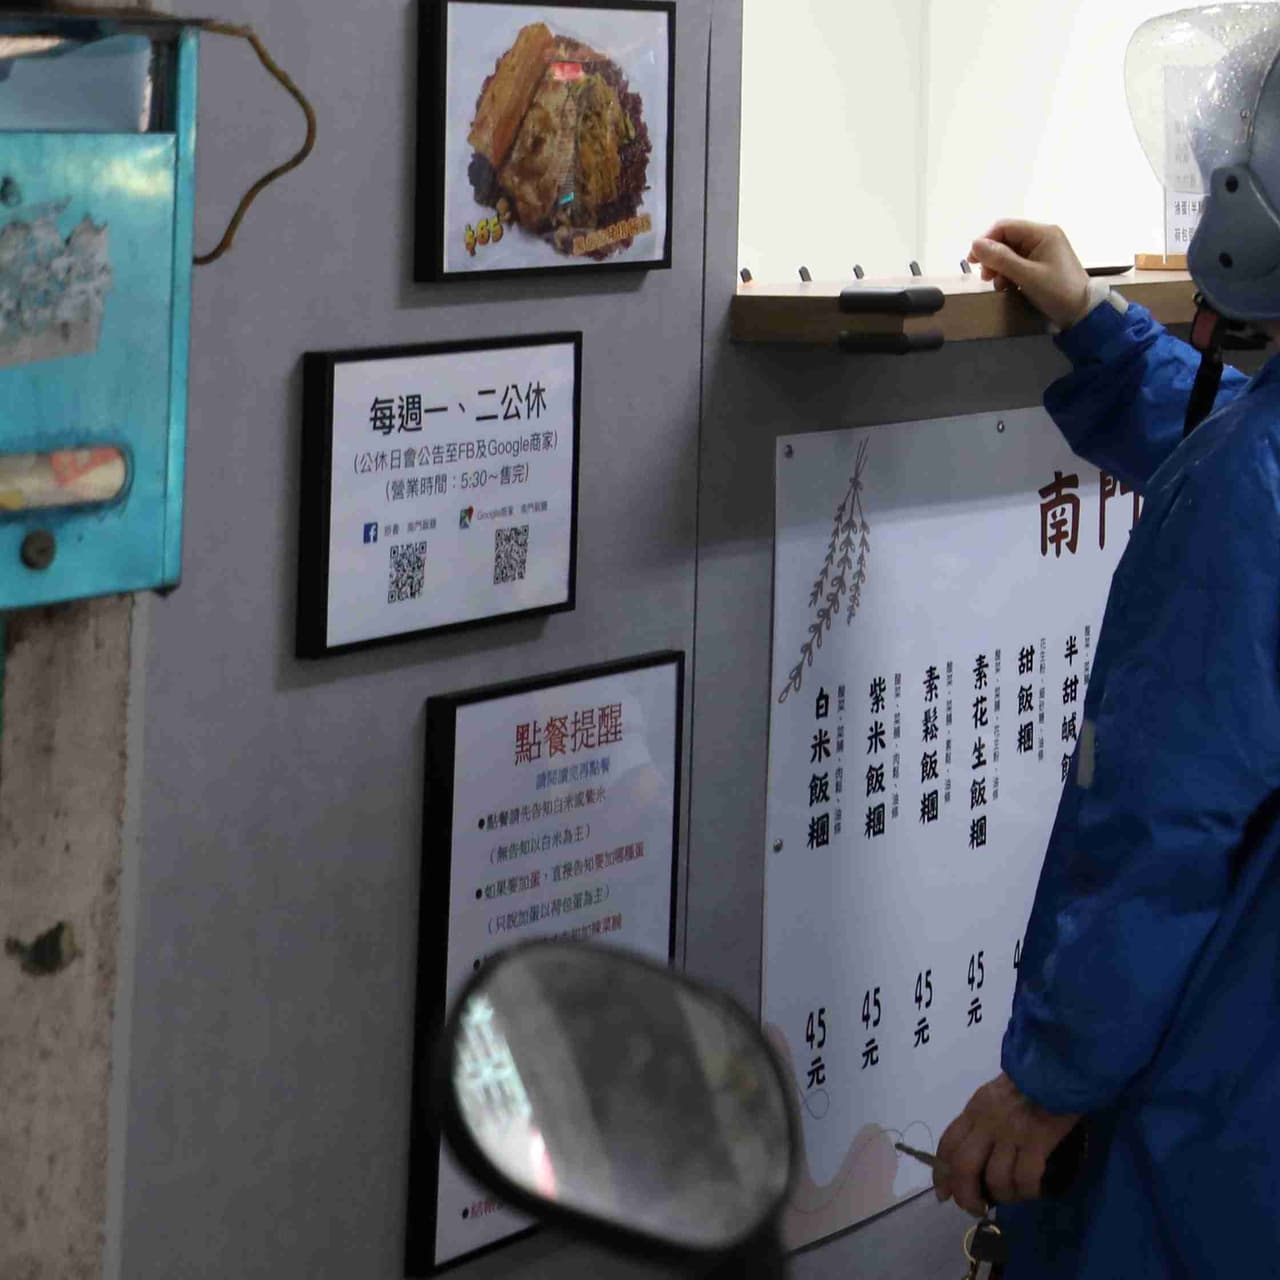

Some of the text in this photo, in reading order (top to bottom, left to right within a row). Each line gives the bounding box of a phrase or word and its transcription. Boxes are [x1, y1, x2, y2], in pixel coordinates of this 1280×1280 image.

[369, 381, 548, 436] 每週一、二公休
[514, 702, 624, 765] 點餐提醒
[1017, 645, 1035, 755] 甜飯糰
[806, 687, 830, 851] 白米飯糰
[864, 676, 886, 839] 紫米飯糰
[919, 666, 941, 825] 素鬆飯糰
[969, 654, 989, 850] 素花生飯糰
[860, 986, 881, 1070] 45元
[914, 969, 933, 1048] 45元
[967, 951, 985, 1027] 45元
[805, 1007, 827, 1089] 45元
